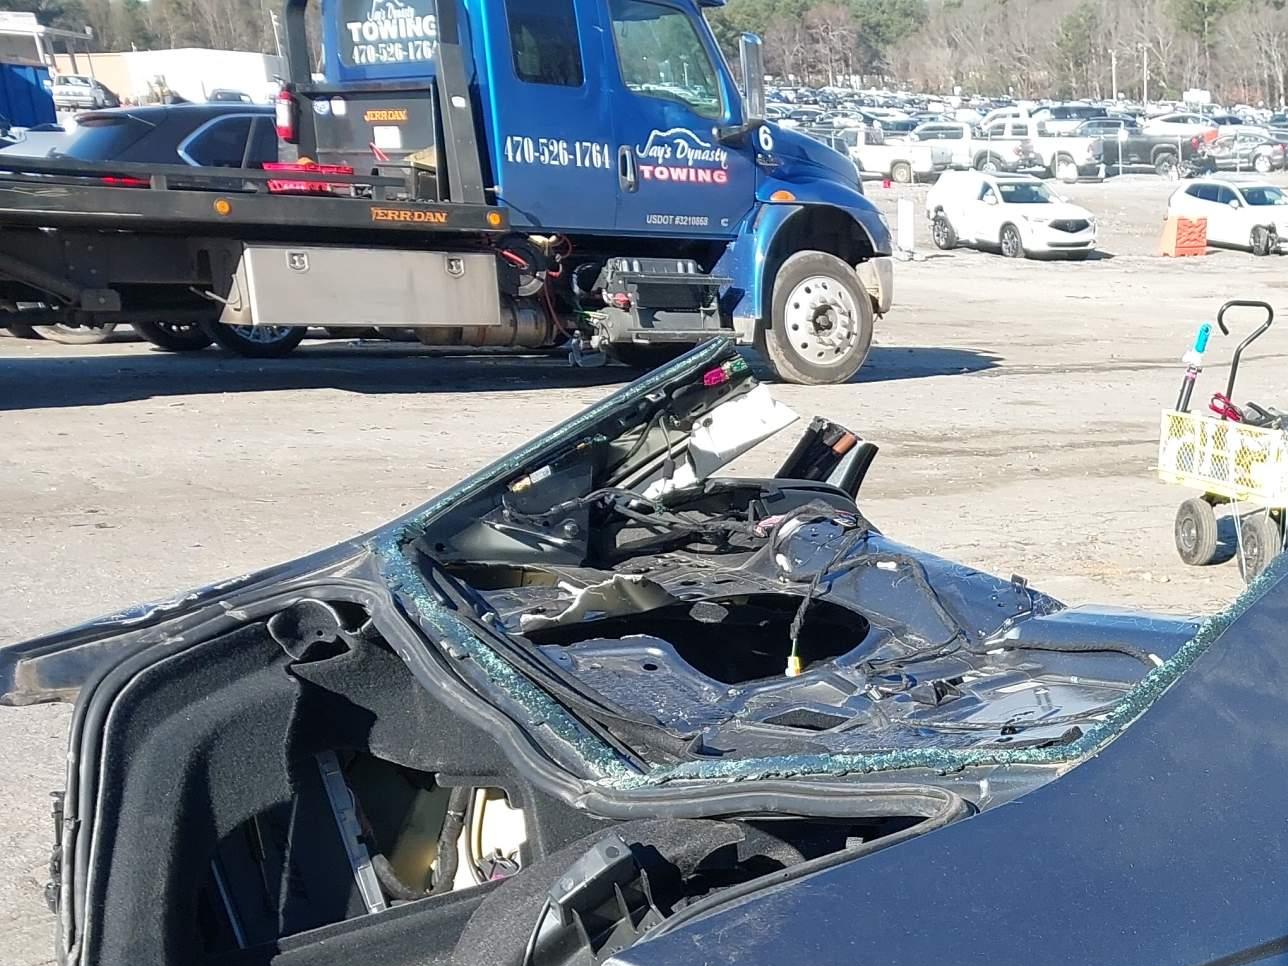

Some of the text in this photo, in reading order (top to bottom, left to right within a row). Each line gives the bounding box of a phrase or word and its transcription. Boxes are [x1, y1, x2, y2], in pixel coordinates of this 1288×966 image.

[346, 14, 437, 42] TOWING
[758, 125, 774, 150] 6
[504, 135, 611, 169] 470-526-1764
[635, 136, 672, 164] Jay's
[673, 139, 729, 169] Dynasty
[639, 165, 728, 183] TOWING
[646, 214, 674, 224] USDOT
